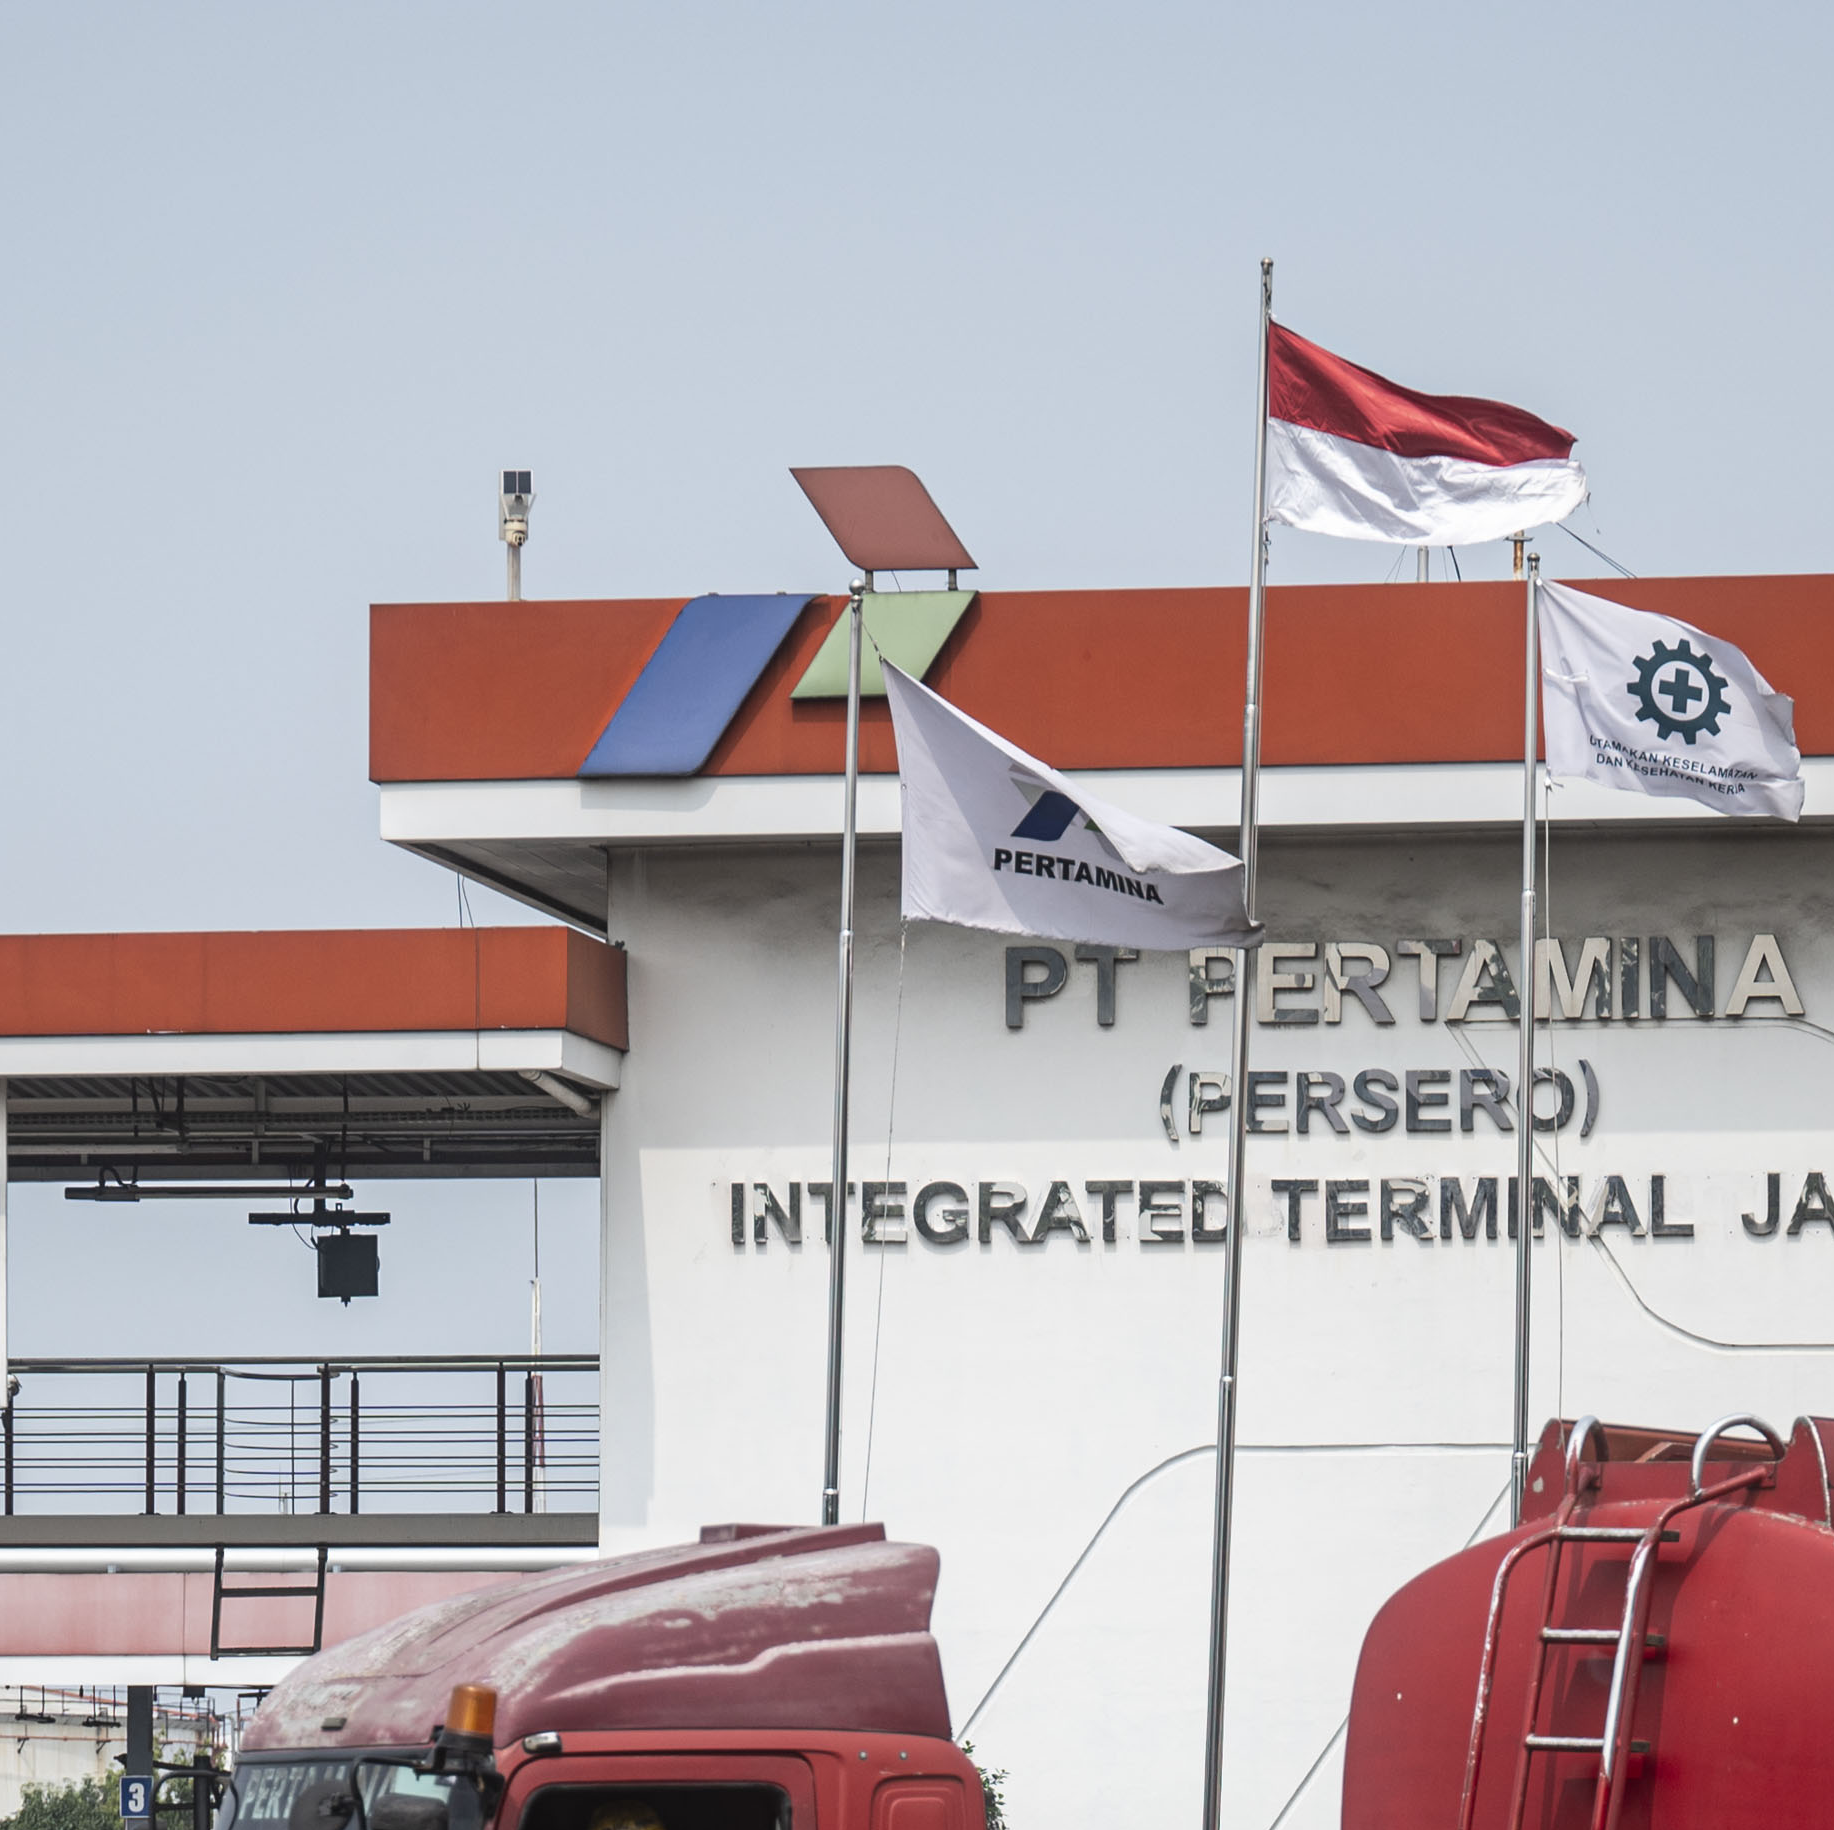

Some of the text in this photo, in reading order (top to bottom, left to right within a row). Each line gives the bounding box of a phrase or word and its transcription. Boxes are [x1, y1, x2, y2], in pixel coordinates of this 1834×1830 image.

[1589, 734, 1759, 781] UTAMAKAN KESELAMATAN
[1596, 752, 1624, 769] DAN
[1625, 757, 1705, 786] KESEHATAN
[994, 848, 1165, 906] PERTAMINA
[1004, 933, 1807, 1029] PT PERTAMINA
[1159, 1059, 1599, 1143] (PERSERO)
[730, 1178, 1231, 1246] INTEGRATED
[1270, 1172, 1695, 1242] TERMINAL
[126, 1782, 146, 1814] 3
